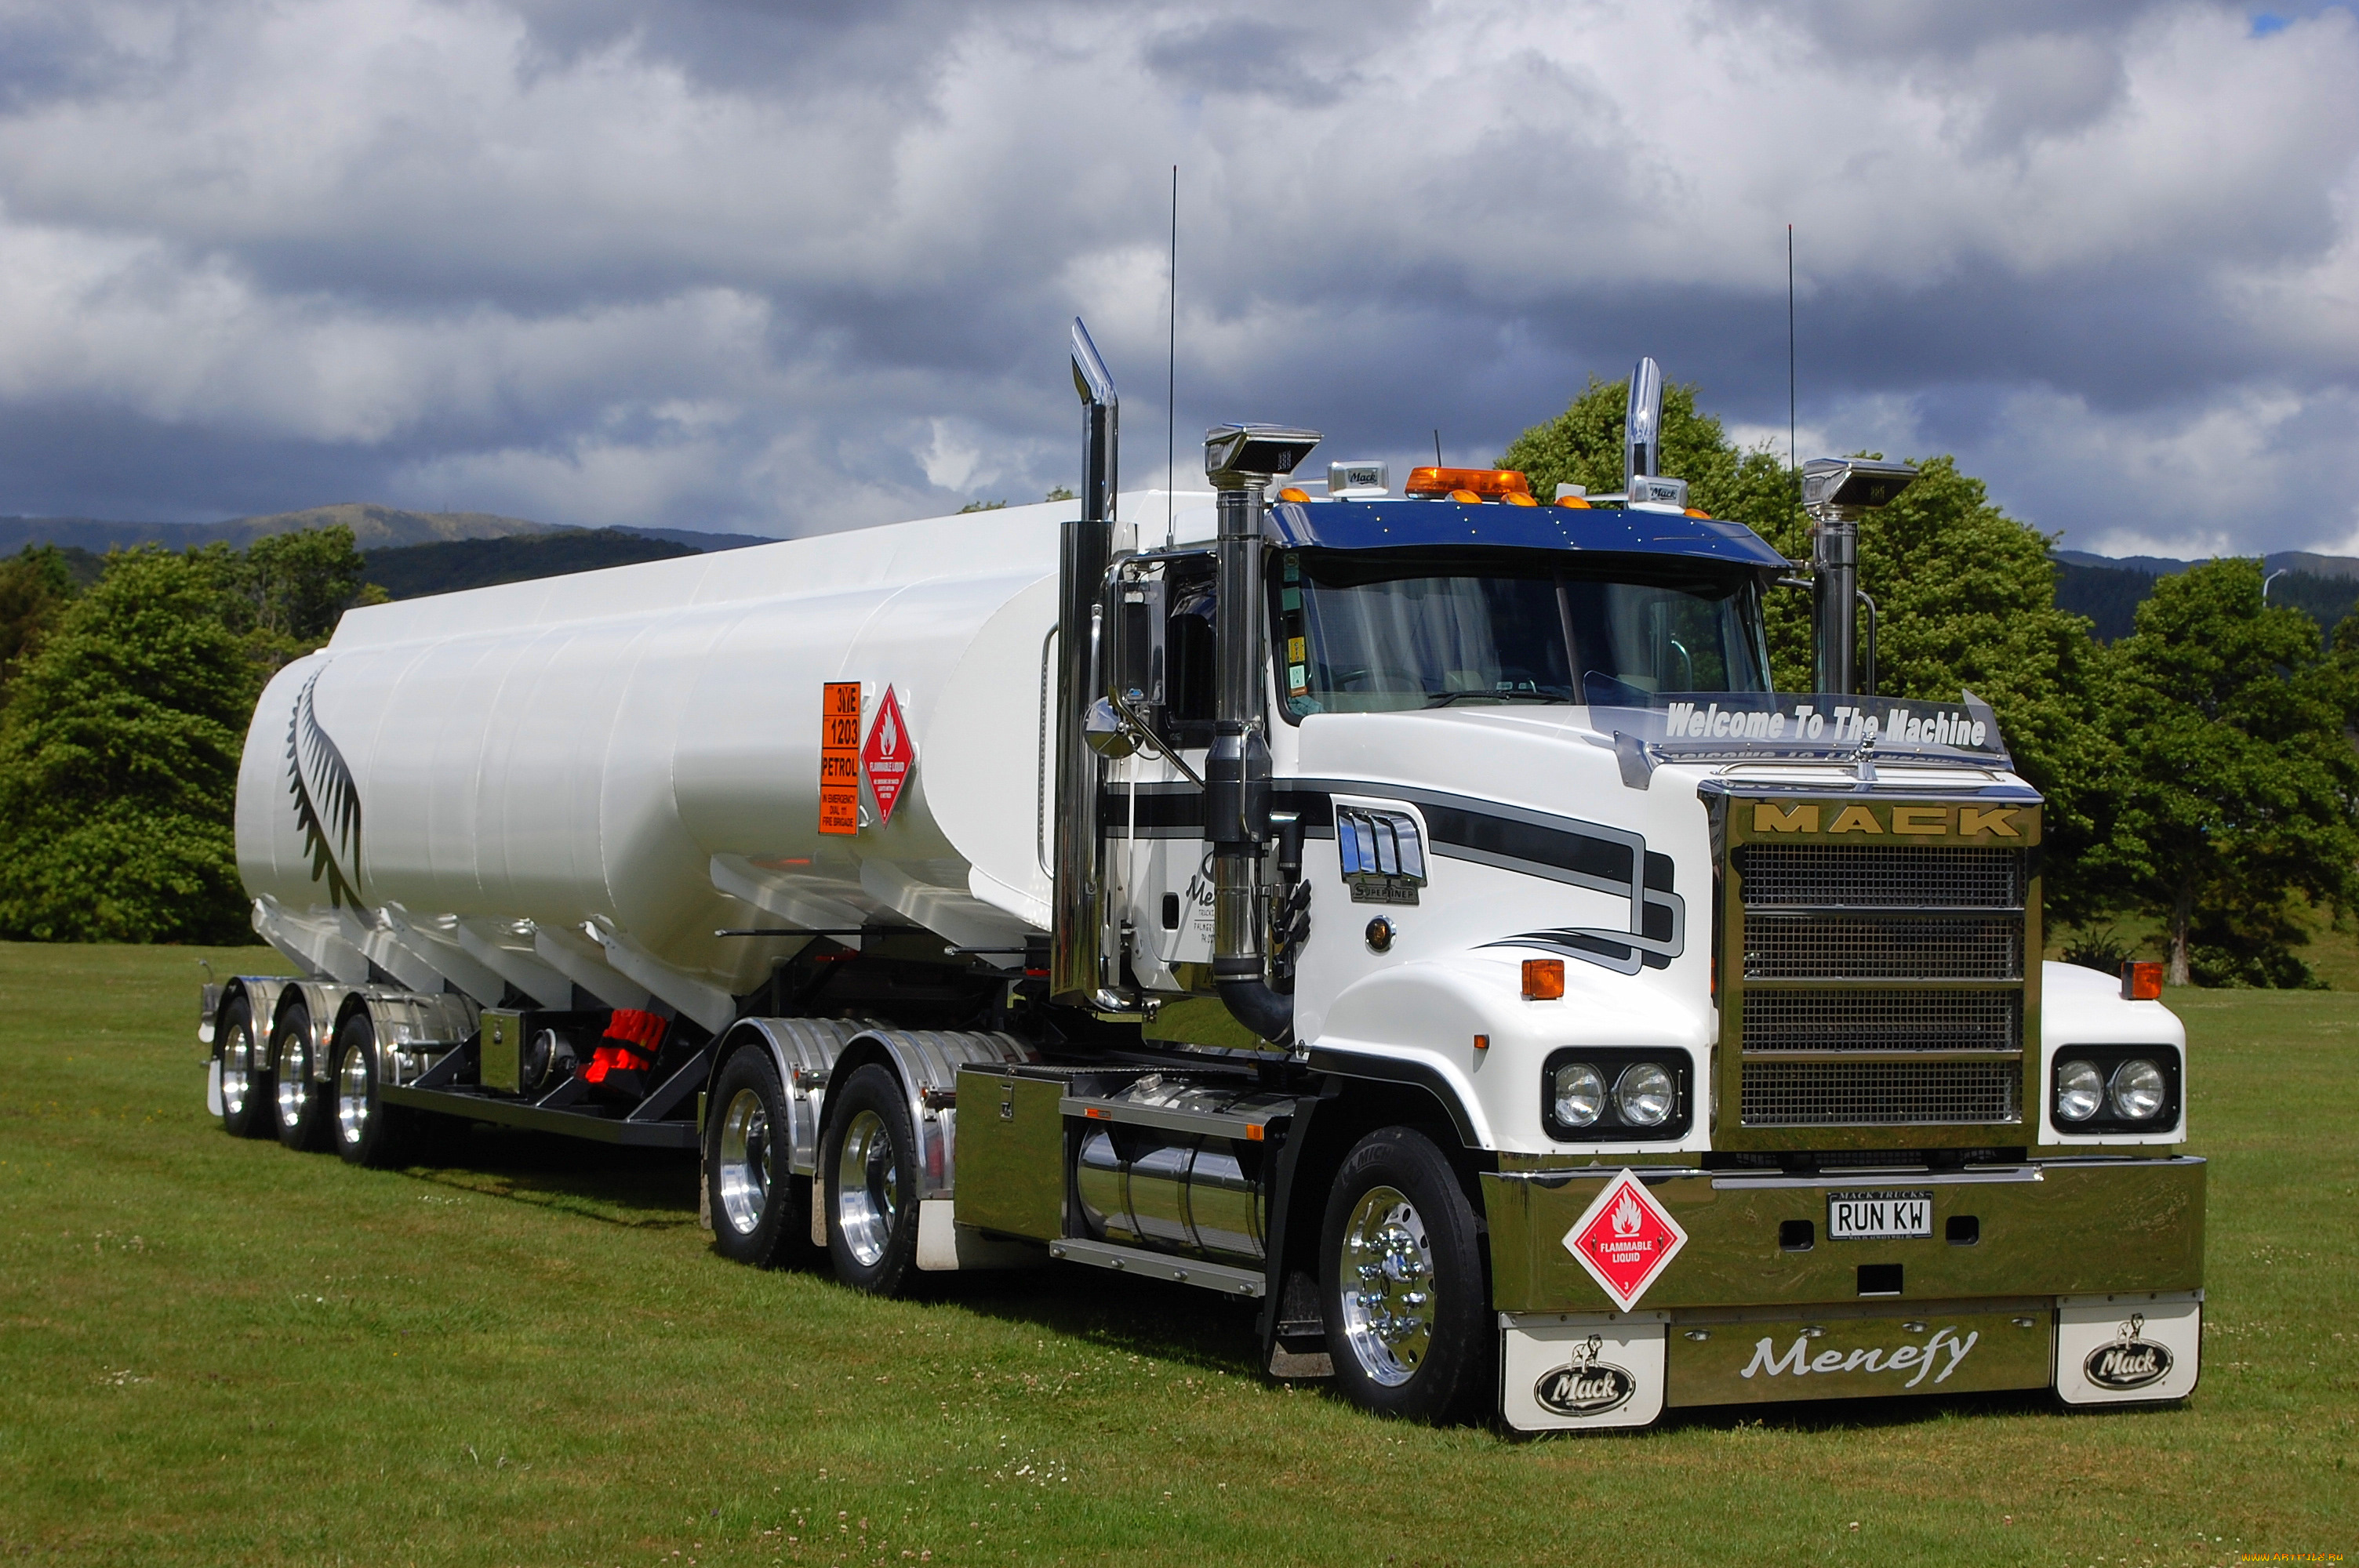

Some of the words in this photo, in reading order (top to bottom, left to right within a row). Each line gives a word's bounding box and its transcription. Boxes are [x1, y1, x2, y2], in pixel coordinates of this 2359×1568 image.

[1350, 472, 1378, 485] Mack
[1651, 487, 1677, 500] Mack
[831, 718, 858, 745] 1203
[1666, 702, 1785, 739] Welcome
[1794, 706, 1824, 739] To
[1833, 706, 1879, 741] The
[1885, 709, 1986, 746] Machine
[822, 757, 857, 776] PETROL
[828, 794, 856, 804] EMERGENCY
[822, 816, 833, 826] FIRE
[833, 817, 854, 827] BRIGADE
[1753, 803, 2021, 837] MACK
[1838, 1203, 1884, 1231] RUN
[1894, 1202, 1923, 1230] KW
[1600, 1240, 1652, 1252] FLAMMABLE
[1612, 1252, 1641, 1263] LIQUID
[1624, 1281, 1629, 1290] 3
[1740, 1326, 1979, 1388] Menefy
[2098, 1348, 2159, 1382] Mack
[1550, 1371, 1619, 1407] Mack
